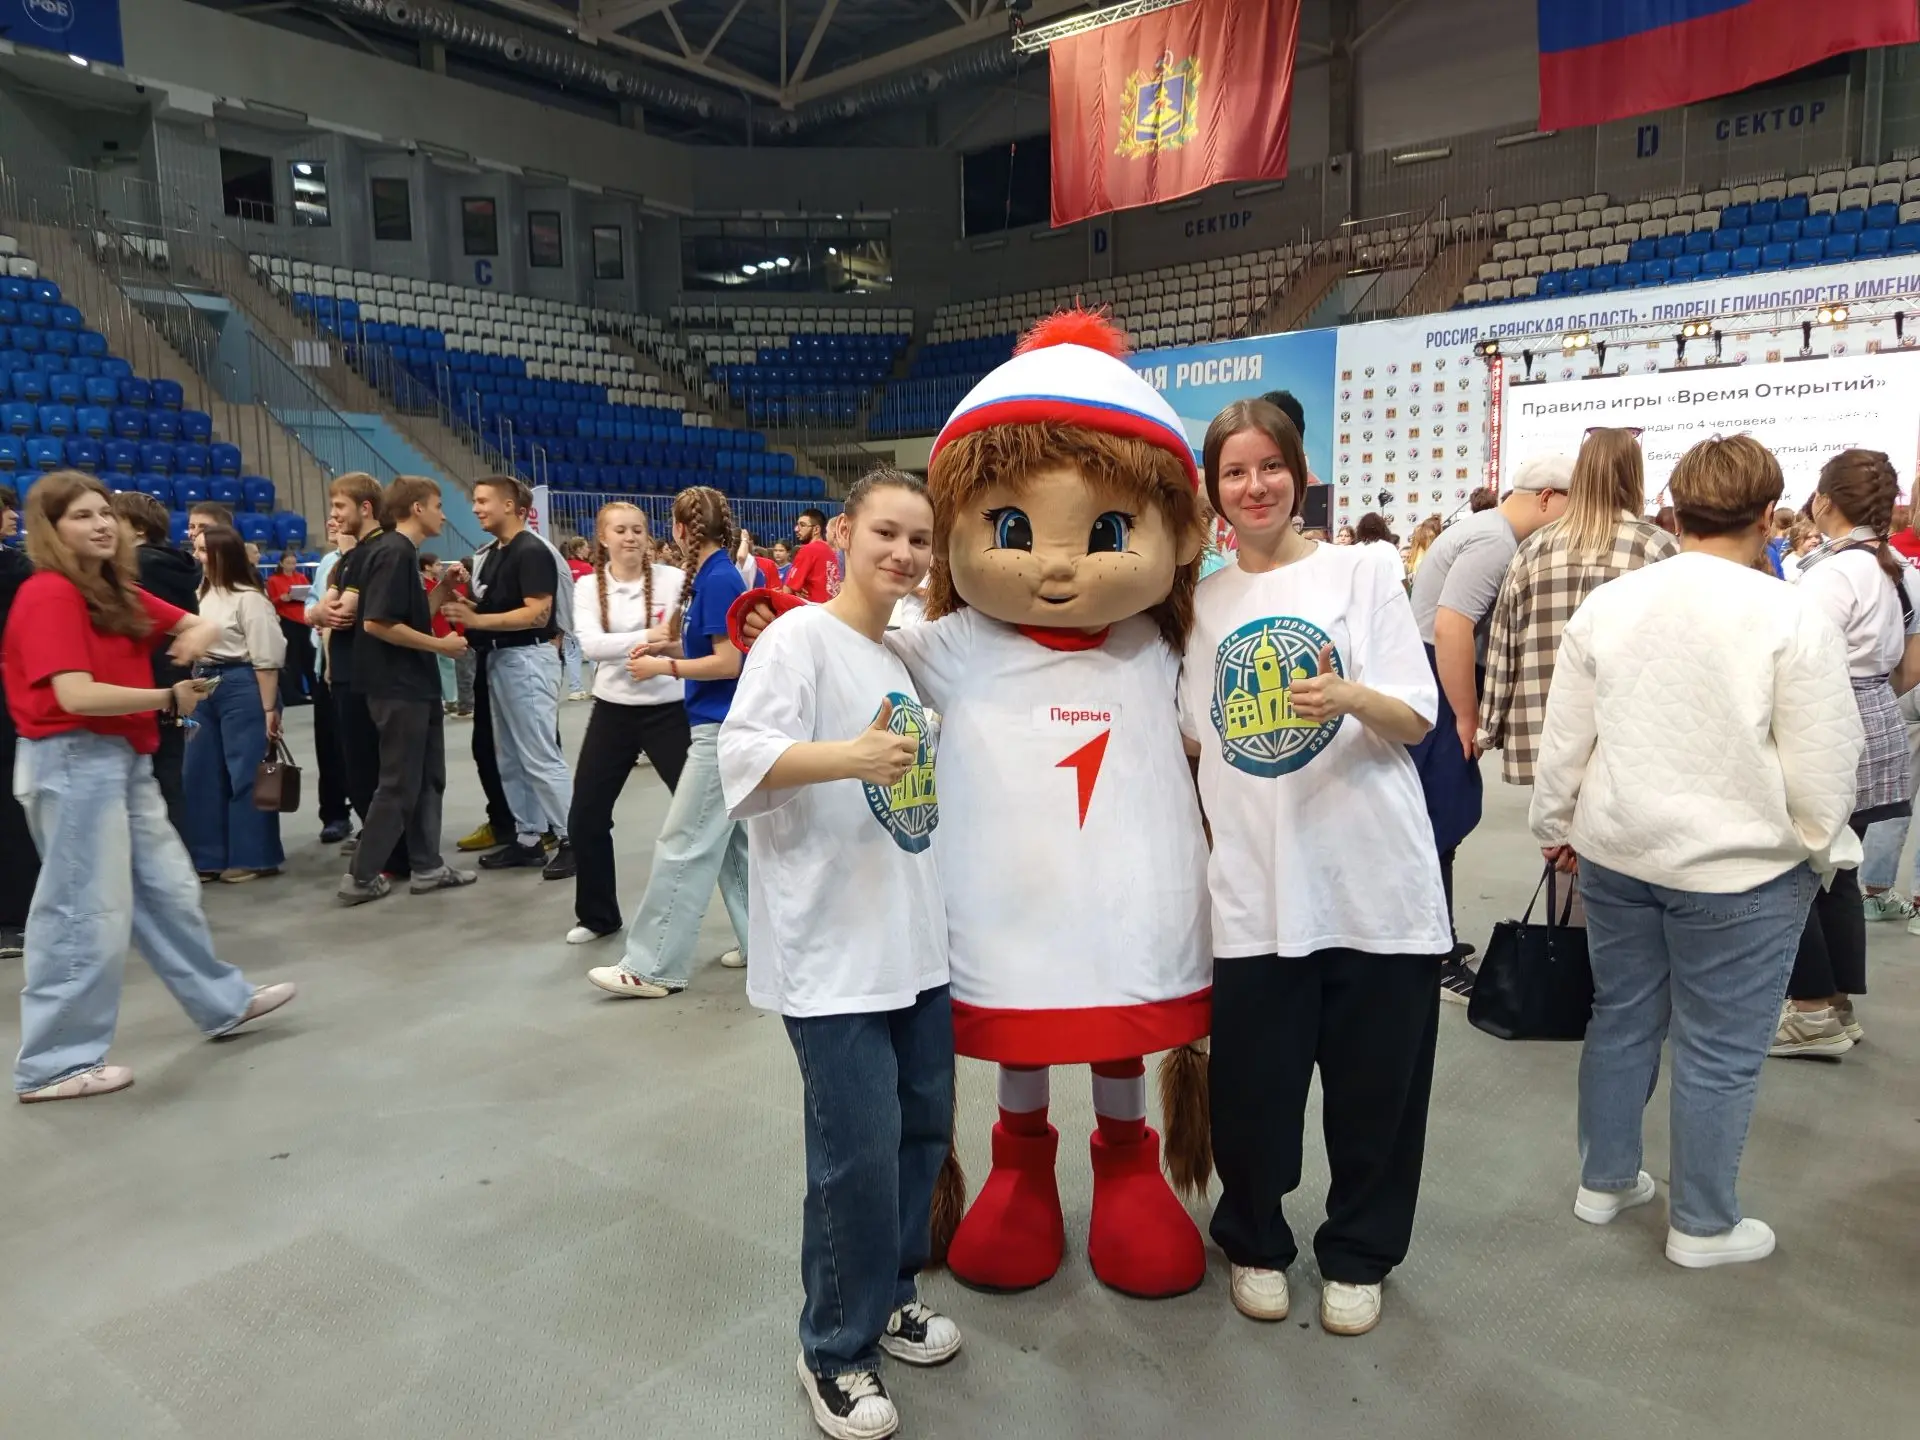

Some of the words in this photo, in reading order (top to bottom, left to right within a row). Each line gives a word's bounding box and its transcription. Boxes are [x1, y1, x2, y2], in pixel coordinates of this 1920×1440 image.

[1716, 102, 1825, 141] СЕКТОР
[1184, 211, 1253, 238] СЕКТОР
[1426, 326, 1479, 349] РОССИЯ
[1489, 316, 1564, 338] БРЯНСКАЯ
[1176, 354, 1263, 389] РОССИЯ
[1522, 399, 1606, 418] Правила
[1611, 395, 1662, 410] игры
[1667, 388, 1749, 407] «Время
[1755, 374, 1887, 398] Открытий»
[1678, 422, 1694, 431] по
[1697, 419, 1705, 429] 4
[1708, 416, 1776, 428] человека
[1050, 707, 1112, 725] Первые
